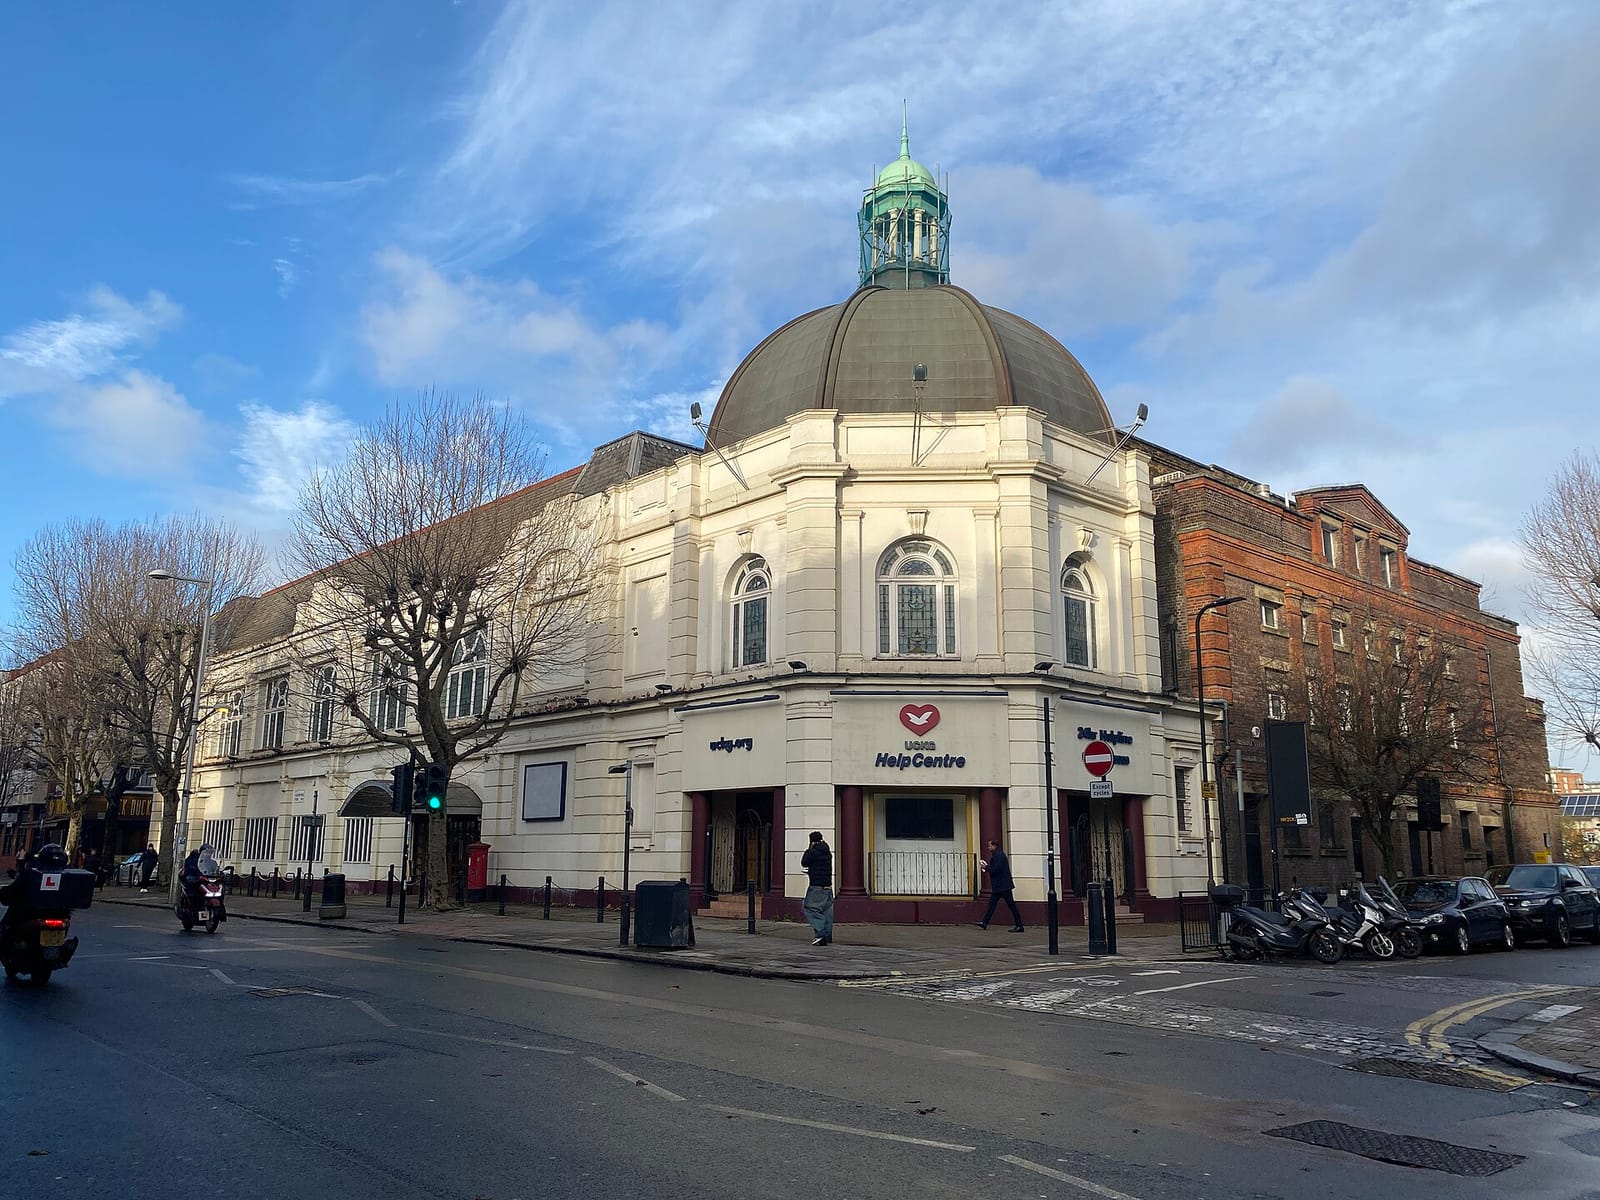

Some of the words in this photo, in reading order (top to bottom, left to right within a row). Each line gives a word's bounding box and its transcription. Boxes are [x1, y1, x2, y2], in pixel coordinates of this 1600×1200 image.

[1099, 729, 1133, 745] Helpline
[904, 740, 936, 750] UCKG
[45, 876, 56, 887] L
